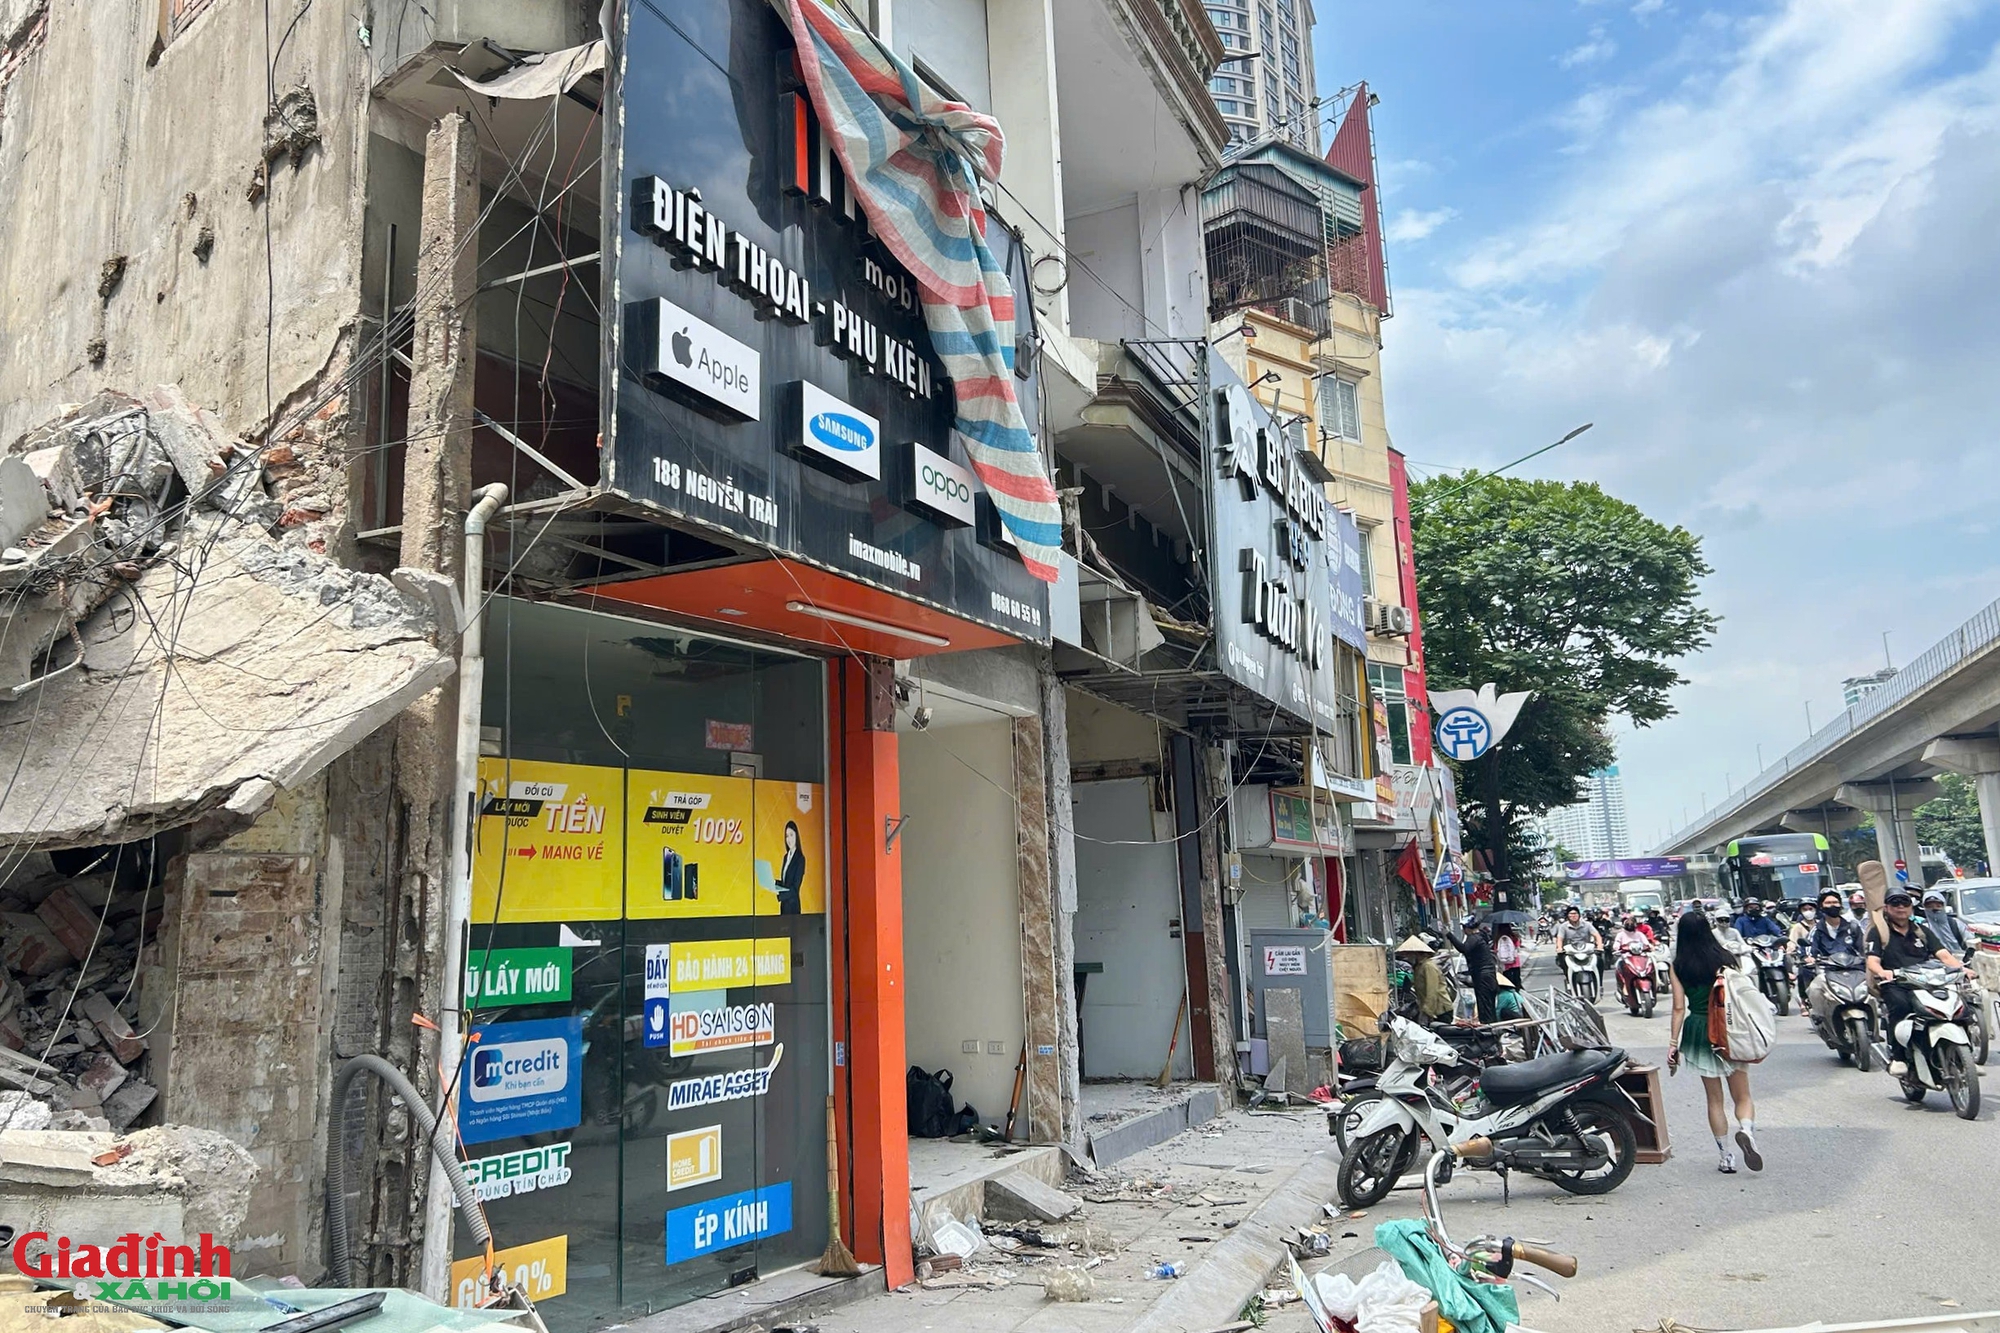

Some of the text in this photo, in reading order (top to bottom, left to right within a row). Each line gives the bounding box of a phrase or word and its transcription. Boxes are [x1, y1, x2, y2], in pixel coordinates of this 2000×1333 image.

[653, 175, 726, 269] ĐIỆN
[735, 231, 810, 324] THOẠI
[833, 300, 877, 375] PHỤ
[885, 339, 932, 400] KIỆN
[865, 256, 919, 317] mobi
[698, 348, 749, 393] Apple
[817, 413, 867, 451] SAMSUNG
[653, 457, 778, 528] 188 NGUYỄN TRÃI
[922, 465, 970, 503] oppo
[849, 532, 921, 582] imaxmobile.vn
[1011, 599, 1020, 619] 60
[1021, 603, 1031, 623] 55
[525, 782, 554, 796] ĐỔI CŨ
[674, 793, 703, 805] TRẢ GÓP
[514, 801, 531, 813] MỚI
[545, 793, 605, 833] TIỀN
[651, 810, 685, 820] SINH VIÊN
[693, 817, 744, 844] 100%
[542, 845, 582, 860] MANG
[485, 960, 520, 996] LẤY
[525, 961, 560, 993] MỚI
[646, 950, 668, 980] ĐẨY
[677, 952, 700, 982] BẢO
[702, 953, 733, 980] HÀNH
[735, 956, 749, 977] 24
[505, 1081, 518, 1090] Khi
[670, 1071, 769, 1106] MIRAE ASSET
[461, 1145, 569, 1186] CREDIT
[672, 1157, 692, 1169] HOME
[672, 1165, 695, 1178] CREDIT
[477, 1183, 509, 1198] DÙNG
[516, 1178, 534, 1190] TÍN
[694, 1199, 768, 1250] ÉP KÍNH
